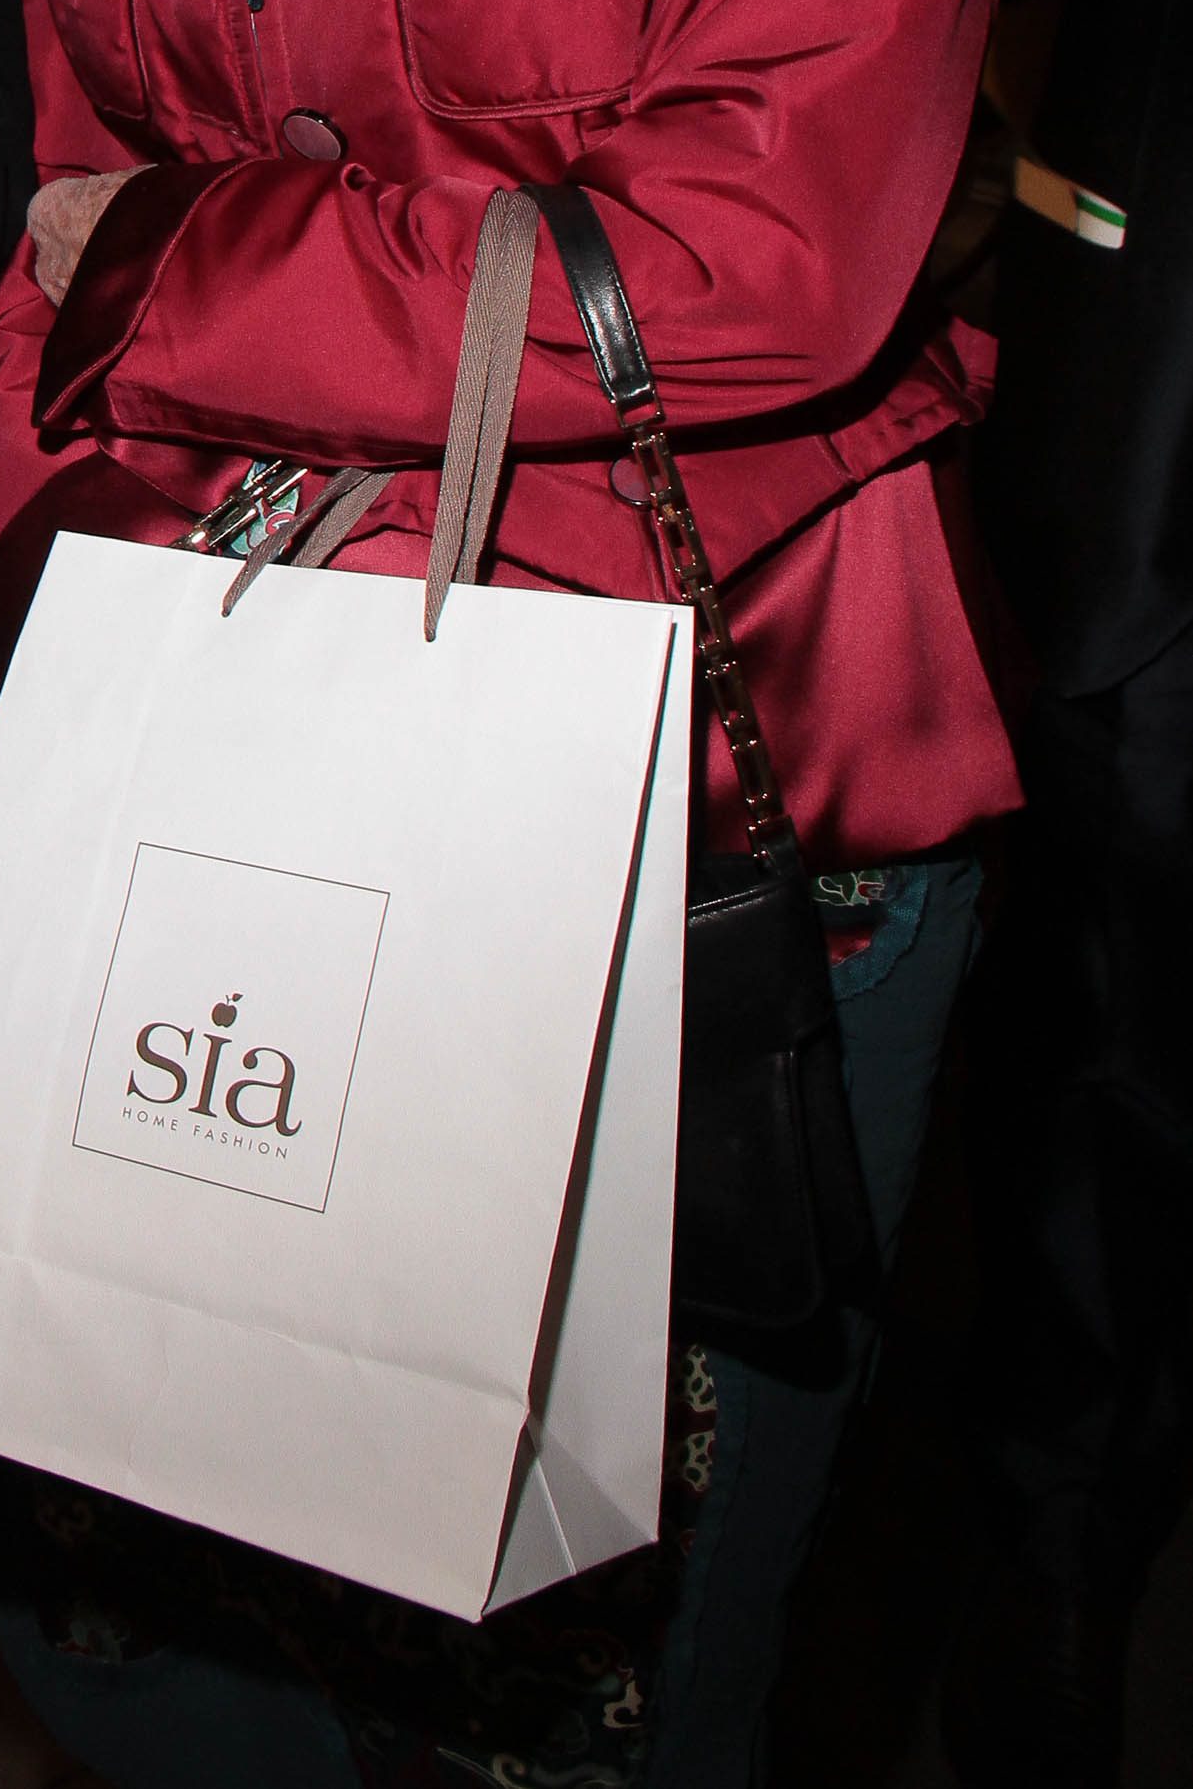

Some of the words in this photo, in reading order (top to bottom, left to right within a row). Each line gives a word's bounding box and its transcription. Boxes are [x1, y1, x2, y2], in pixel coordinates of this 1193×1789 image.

[126, 993, 303, 1138] sia
[121, 1106, 179, 1132] HOME
[192, 1124, 290, 1160] FASHION
